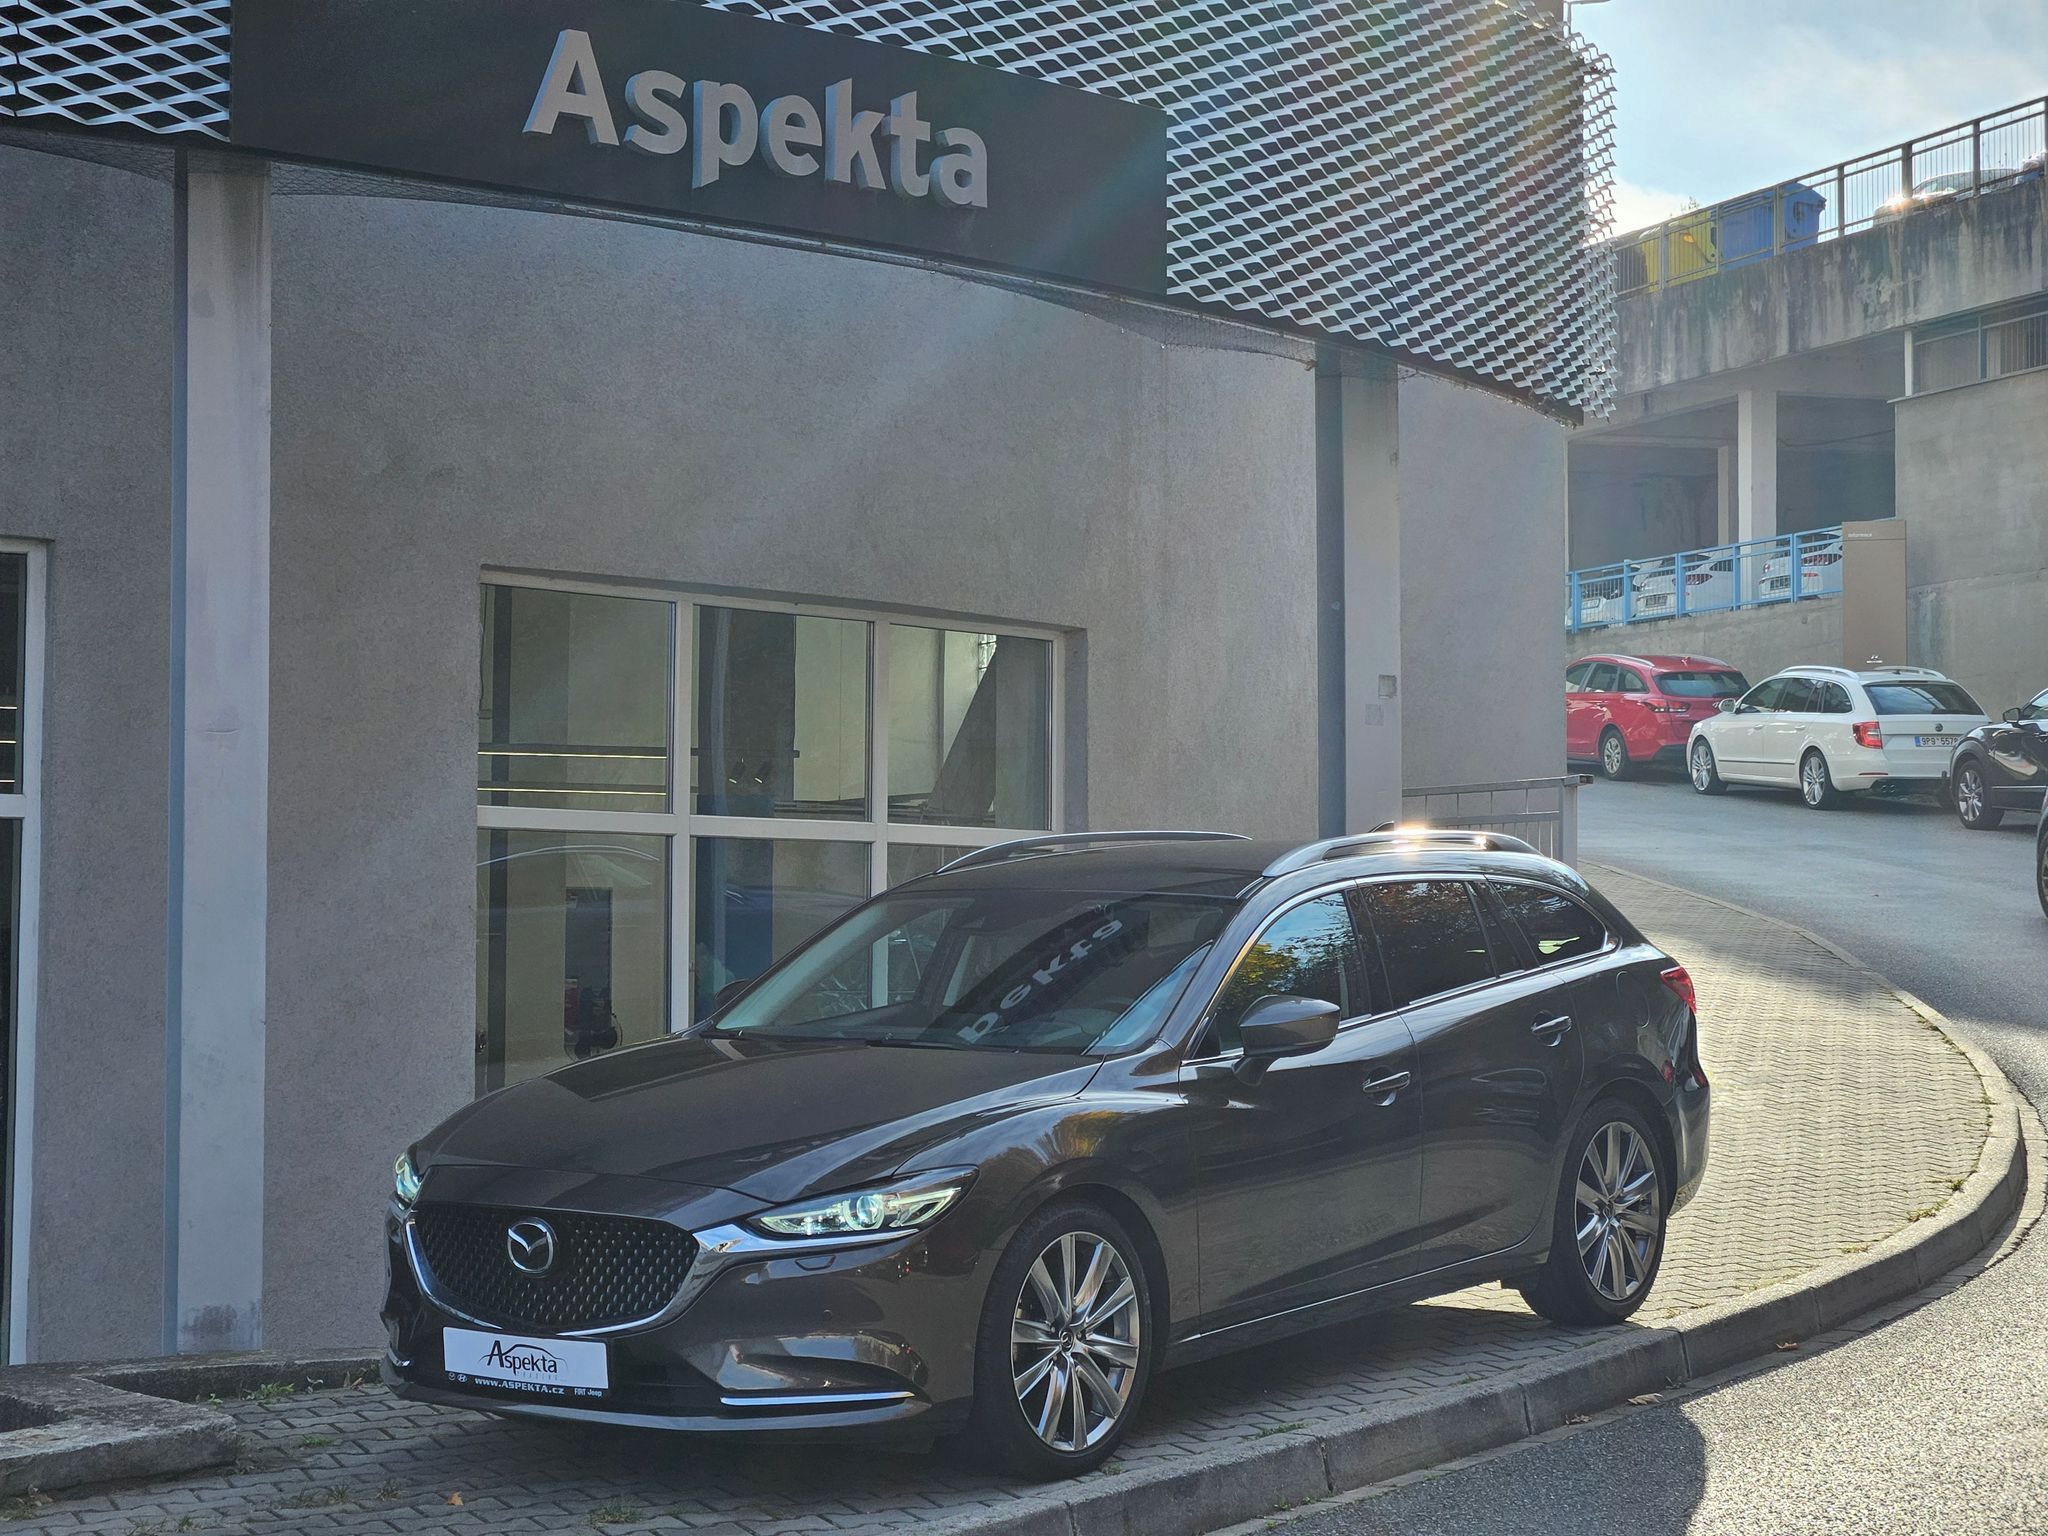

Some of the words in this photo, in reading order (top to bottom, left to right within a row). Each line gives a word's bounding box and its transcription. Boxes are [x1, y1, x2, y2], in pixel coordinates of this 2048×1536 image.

[522, 28, 988, 209] Aspekta
[486, 1339, 558, 1376] Aspekta
[474, 1377, 565, 1395] www.ASPEKTA.cz
